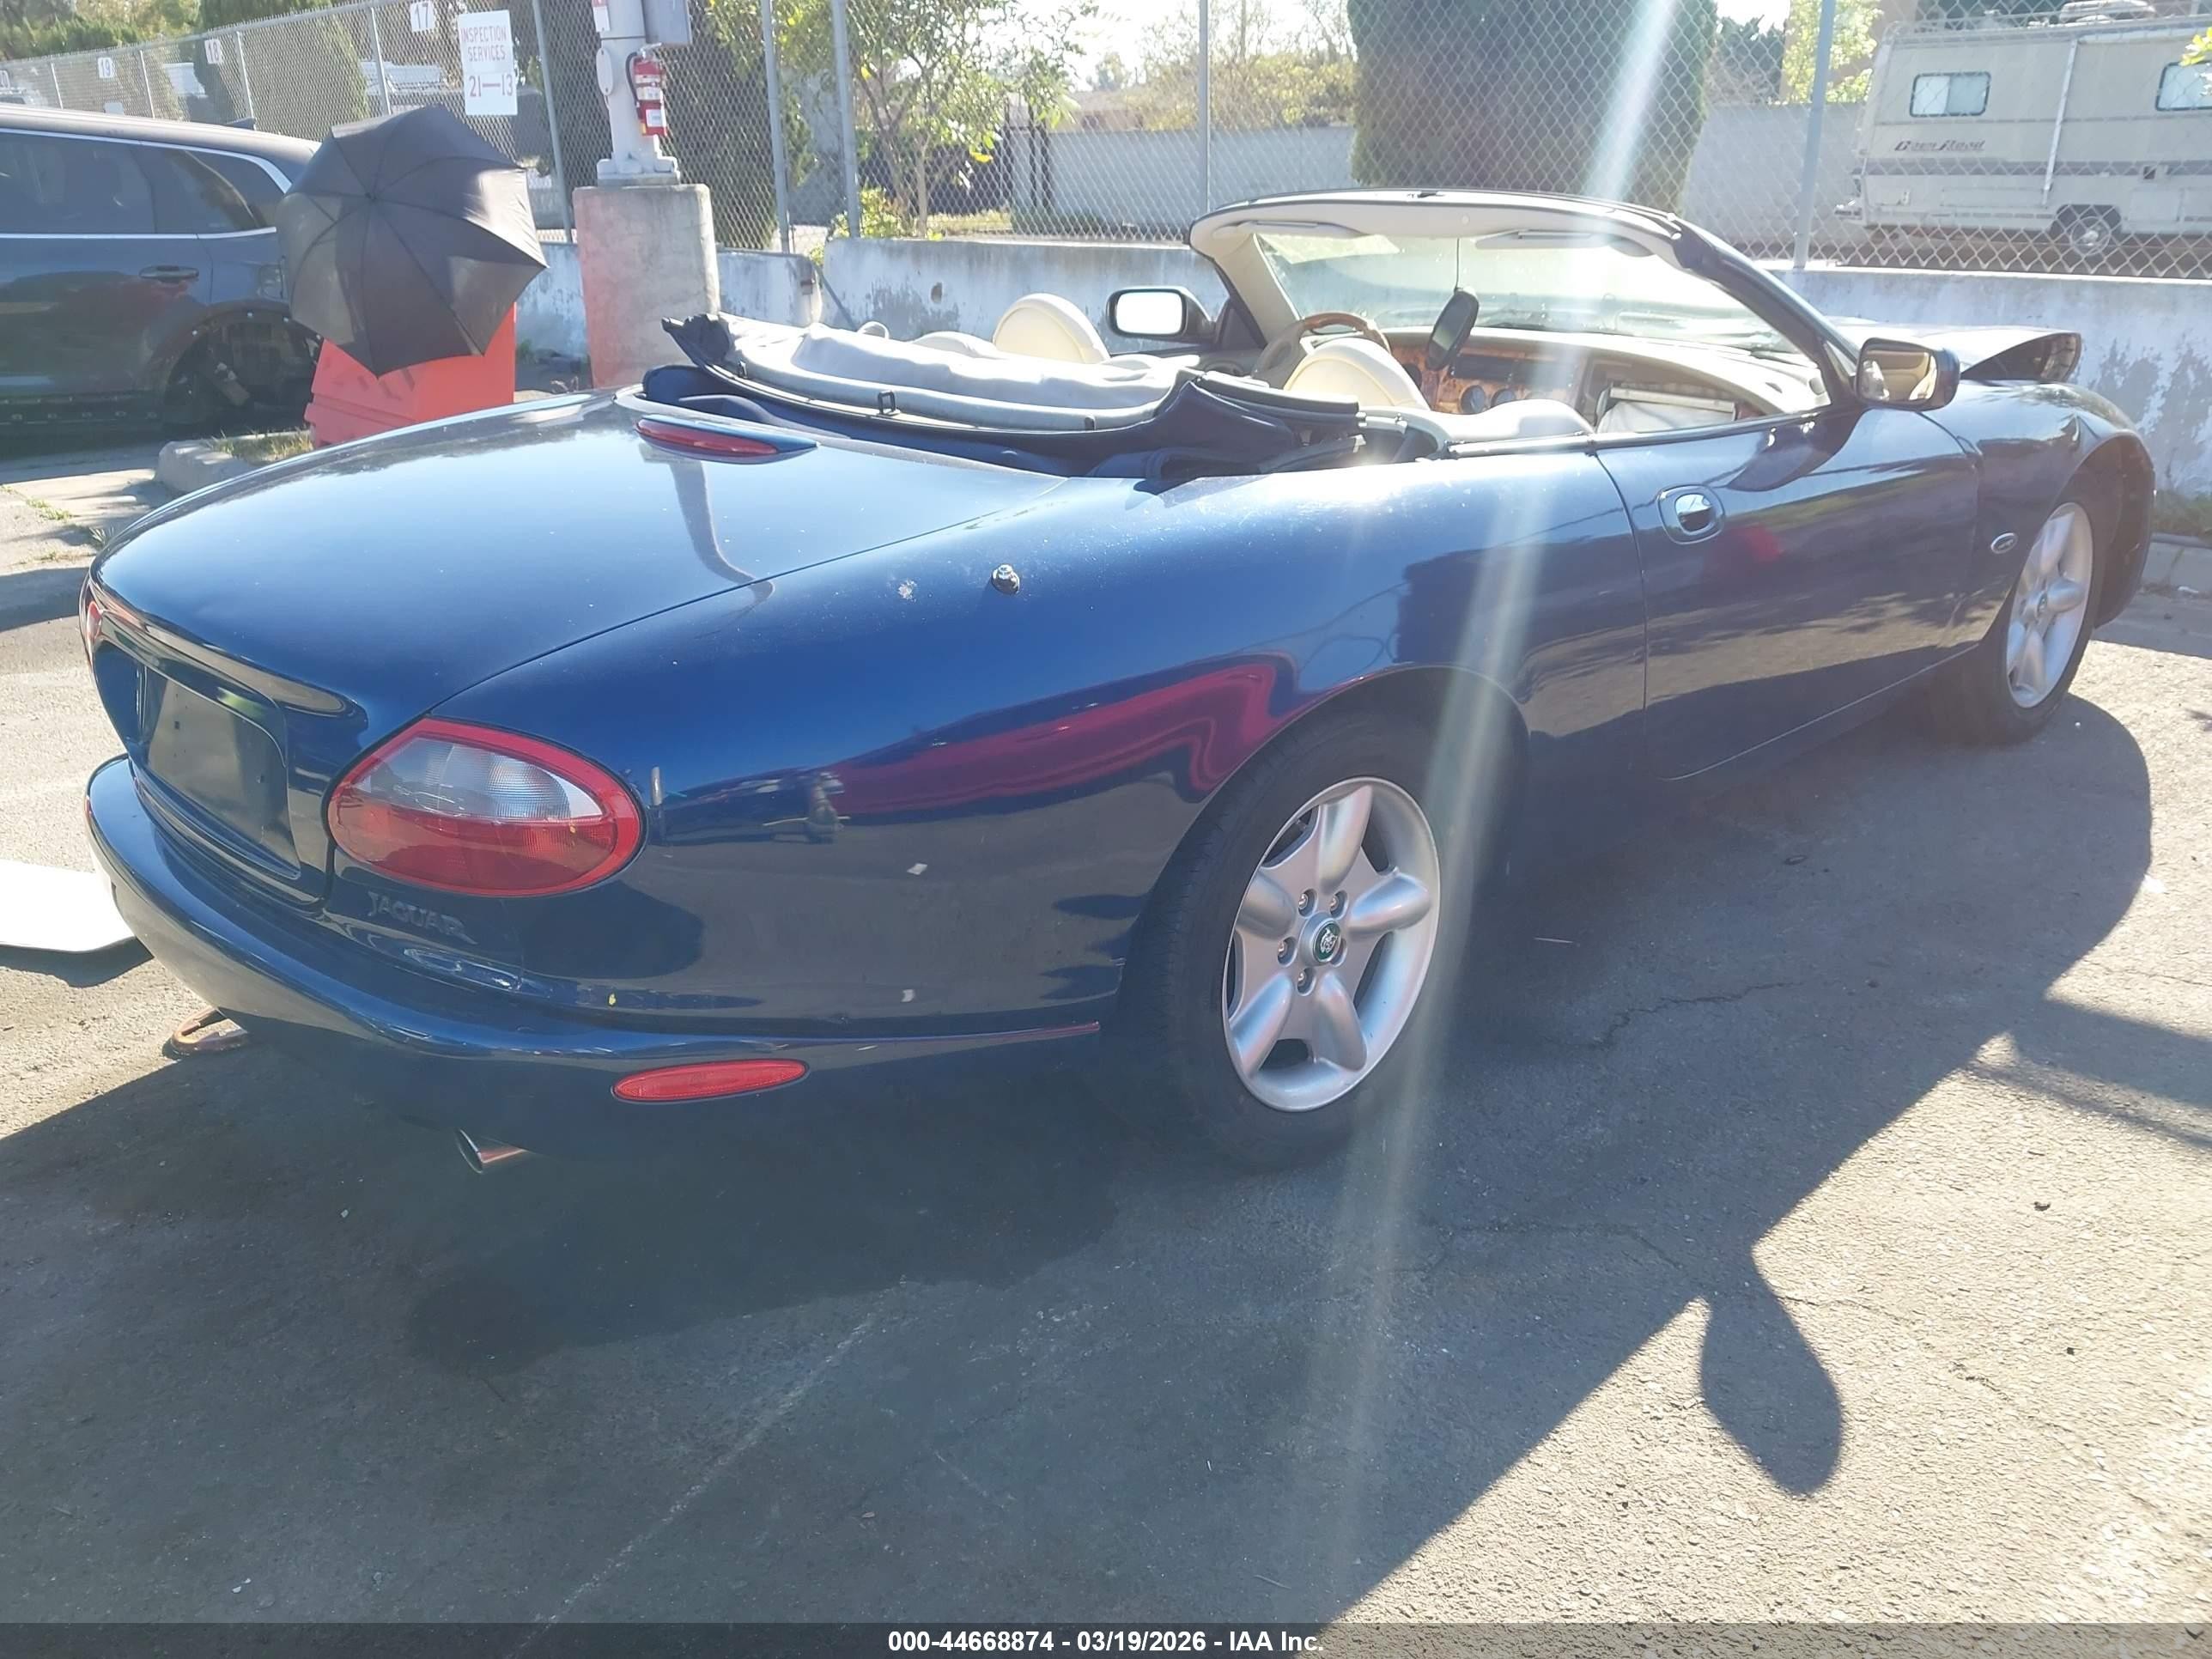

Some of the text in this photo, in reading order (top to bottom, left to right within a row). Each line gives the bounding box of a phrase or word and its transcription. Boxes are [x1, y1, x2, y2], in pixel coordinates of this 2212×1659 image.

[414, 2, 428, 28] 17
[460, 25, 507, 44] INSPECTION
[208, 41, 220, 62] 18
[467, 45, 506, 62] SERVICES
[100, 58, 111, 76] 19
[368, 890, 478, 945] JAGUAR
